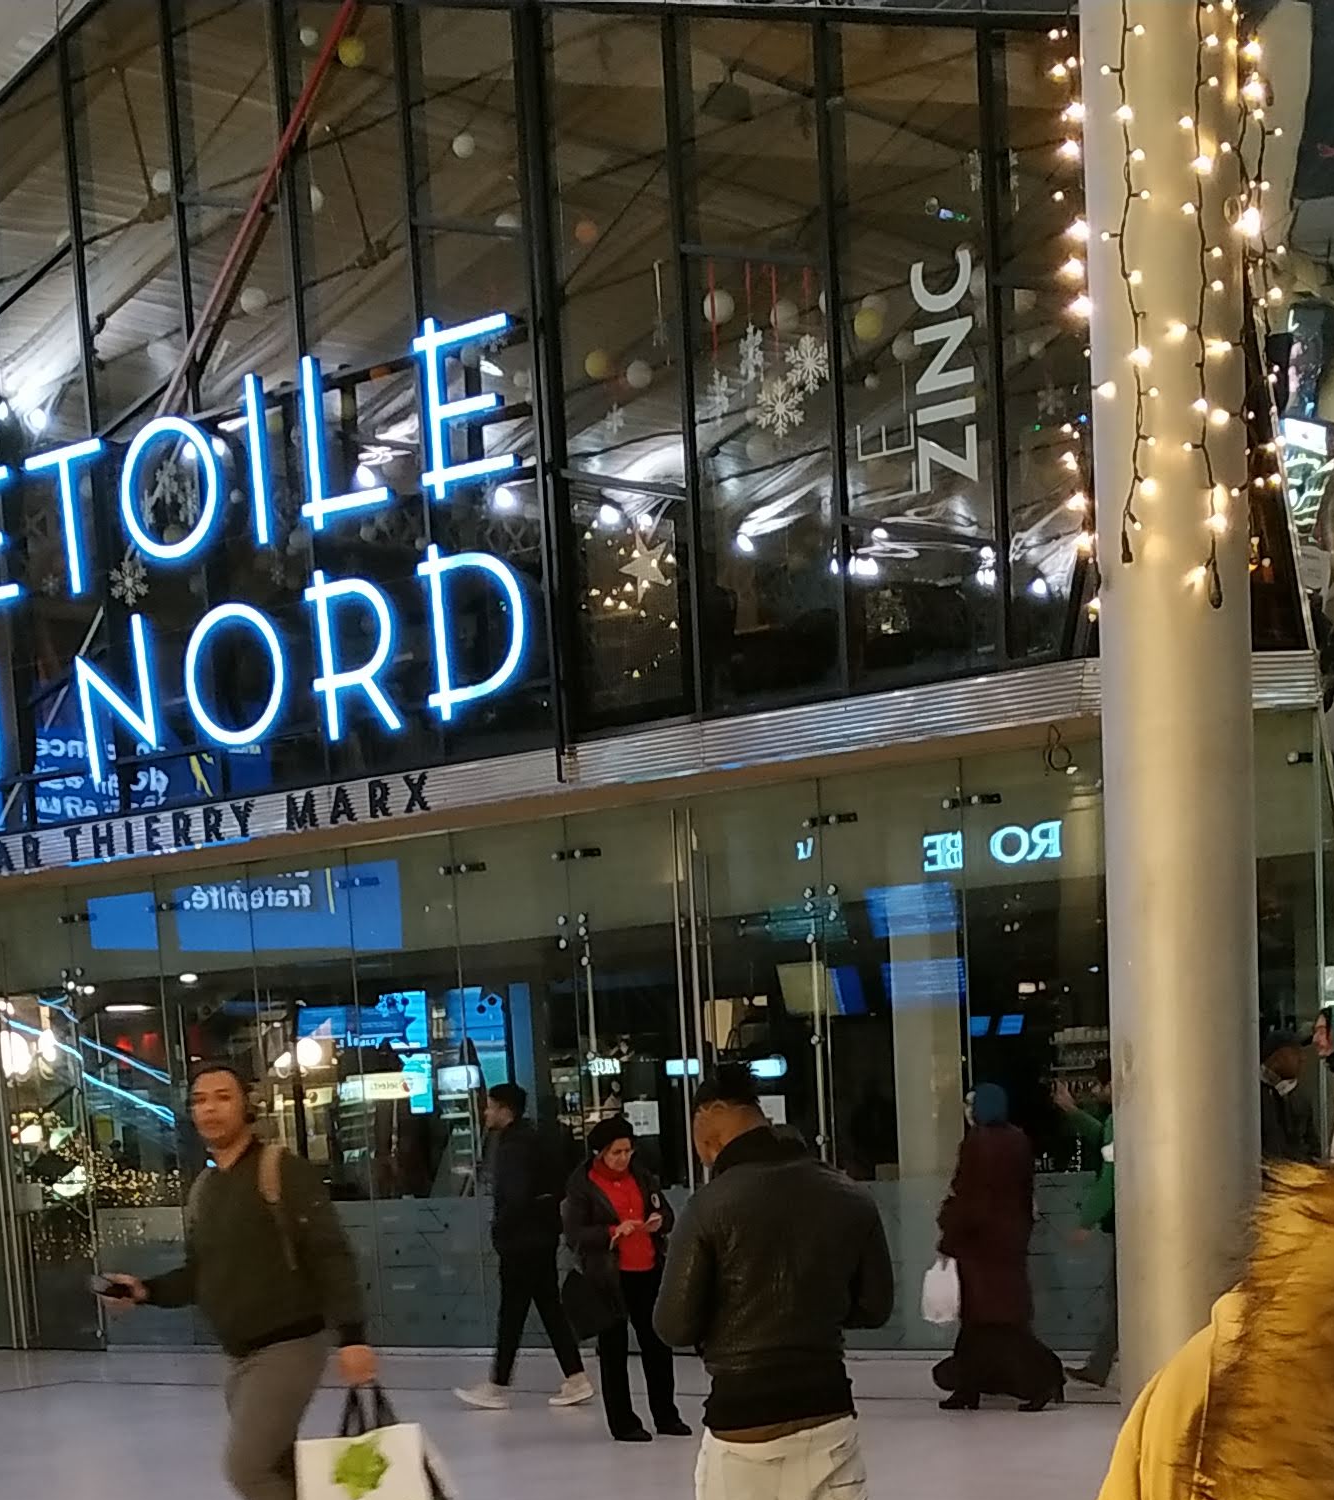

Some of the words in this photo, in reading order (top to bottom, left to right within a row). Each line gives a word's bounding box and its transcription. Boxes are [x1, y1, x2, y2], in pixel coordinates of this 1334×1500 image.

[910, 248, 980, 494] ZINC
[856, 412, 917, 506] LE
[73, 542, 527, 786] NORD
[63, 799, 256, 863] THIERRY
[284, 770, 431, 833] MARX
